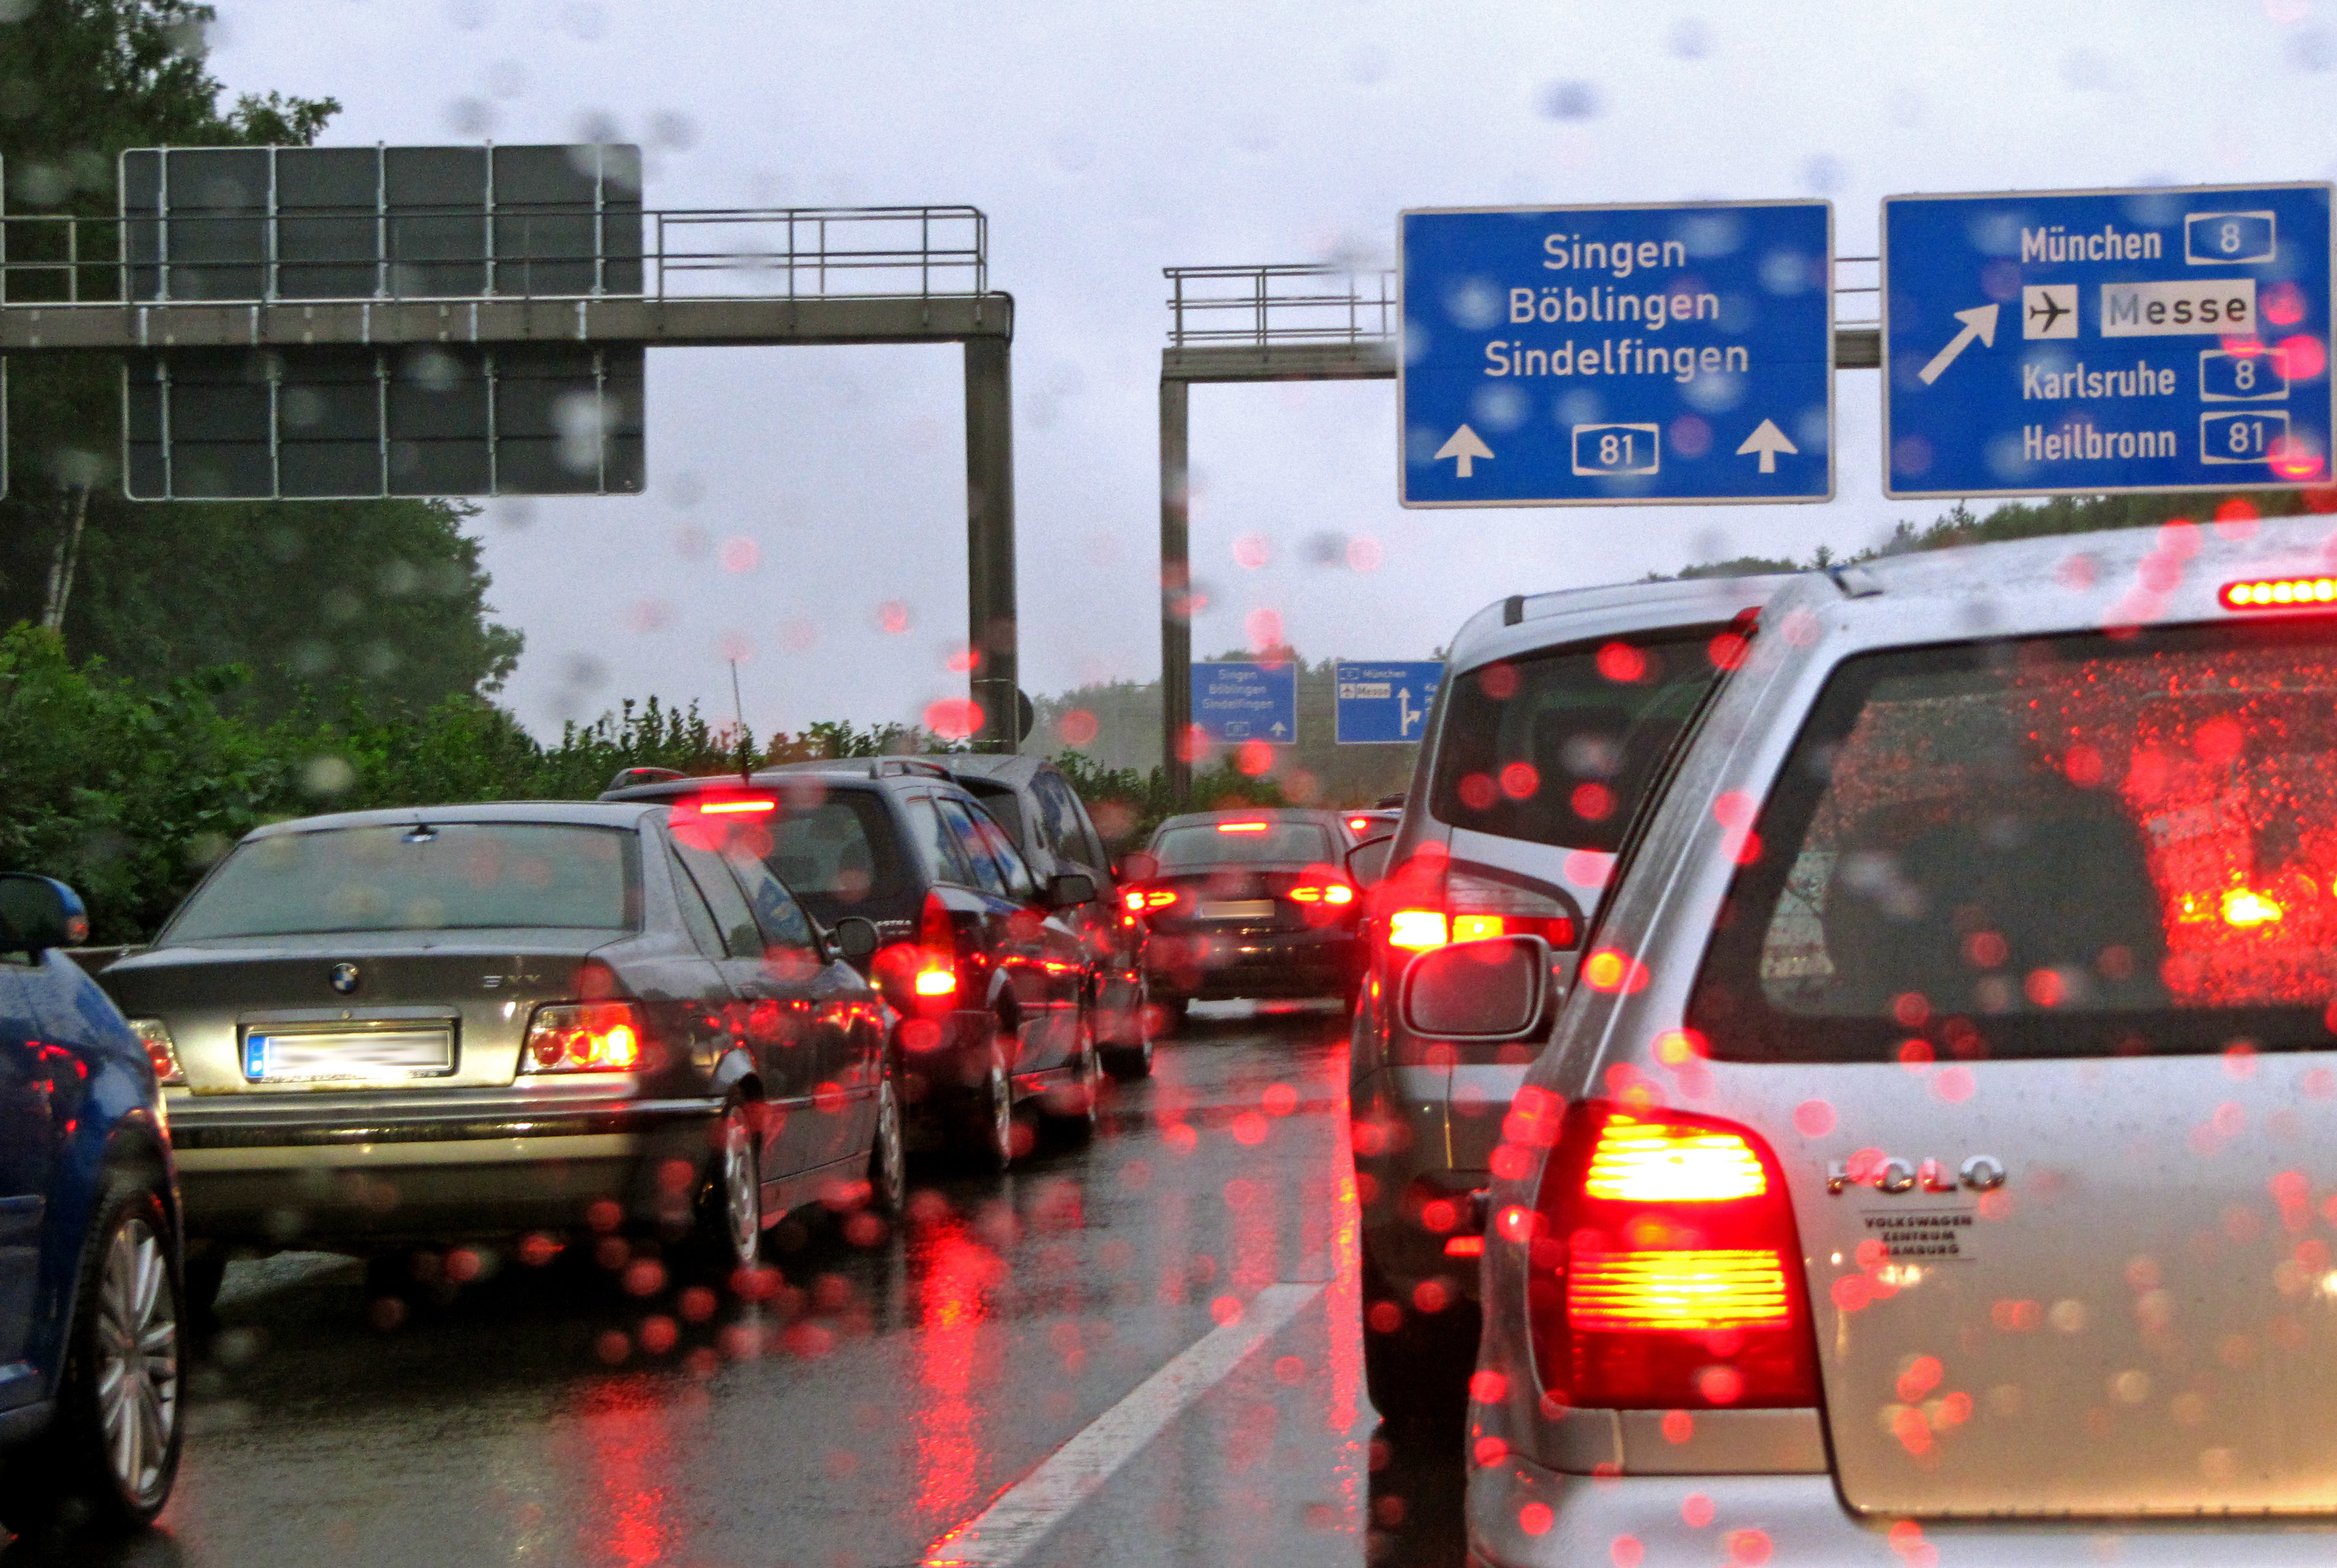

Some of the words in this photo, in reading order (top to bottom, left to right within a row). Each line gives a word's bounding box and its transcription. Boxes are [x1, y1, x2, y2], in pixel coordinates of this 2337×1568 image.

[1543, 234, 1686, 277] Singen
[2022, 225, 2162, 263] München
[2220, 224, 2240, 252] 8
[1509, 286, 1719, 330] Böblingen
[2110, 295, 2247, 326] Messe
[1484, 339, 1748, 382] Sindelfingen
[2023, 361, 2175, 400] Karlsruhe
[2235, 359, 2255, 390] 8
[1599, 435, 1632, 465] 81
[2023, 423, 2177, 460] Heilbronn
[2229, 422, 2263, 452] 81
[1827, 1154, 2006, 1195] POLO
[1865, 1215, 1972, 1227] VOLKSWAGEN
[1882, 1231, 1955, 1241] ZENTRUM
[1879, 1244, 1959, 1256] HAMBURG
